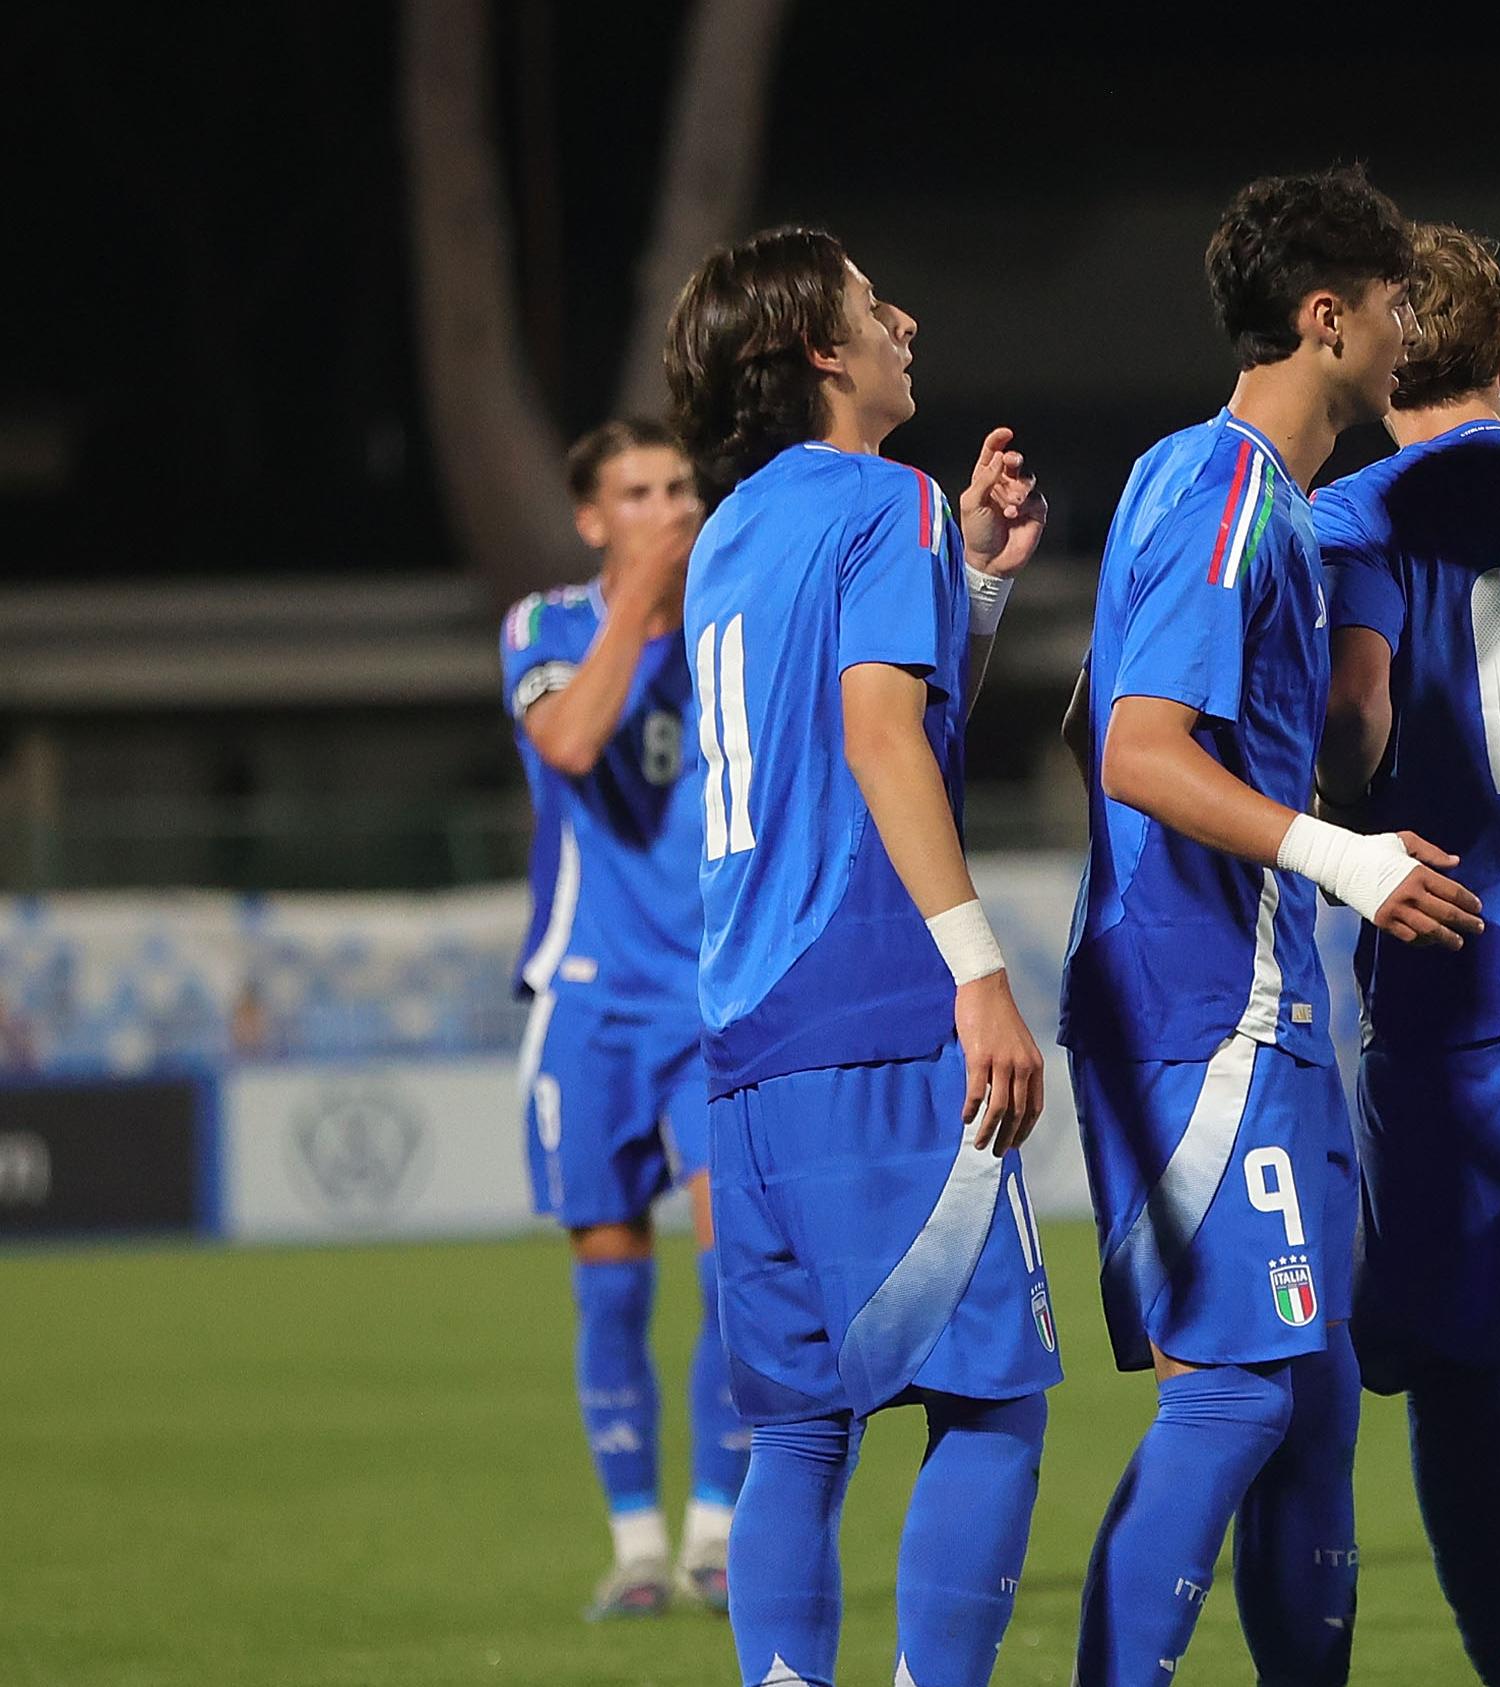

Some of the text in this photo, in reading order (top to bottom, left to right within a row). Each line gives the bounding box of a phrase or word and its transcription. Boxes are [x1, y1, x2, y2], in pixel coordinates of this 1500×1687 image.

[641, 709, 682, 786] 8
[697, 612, 756, 861] 11
[1007, 1172, 1042, 1273] 11
[1244, 1146, 1305, 1247] 9
[1274, 1269, 1309, 1287] ITALIA
